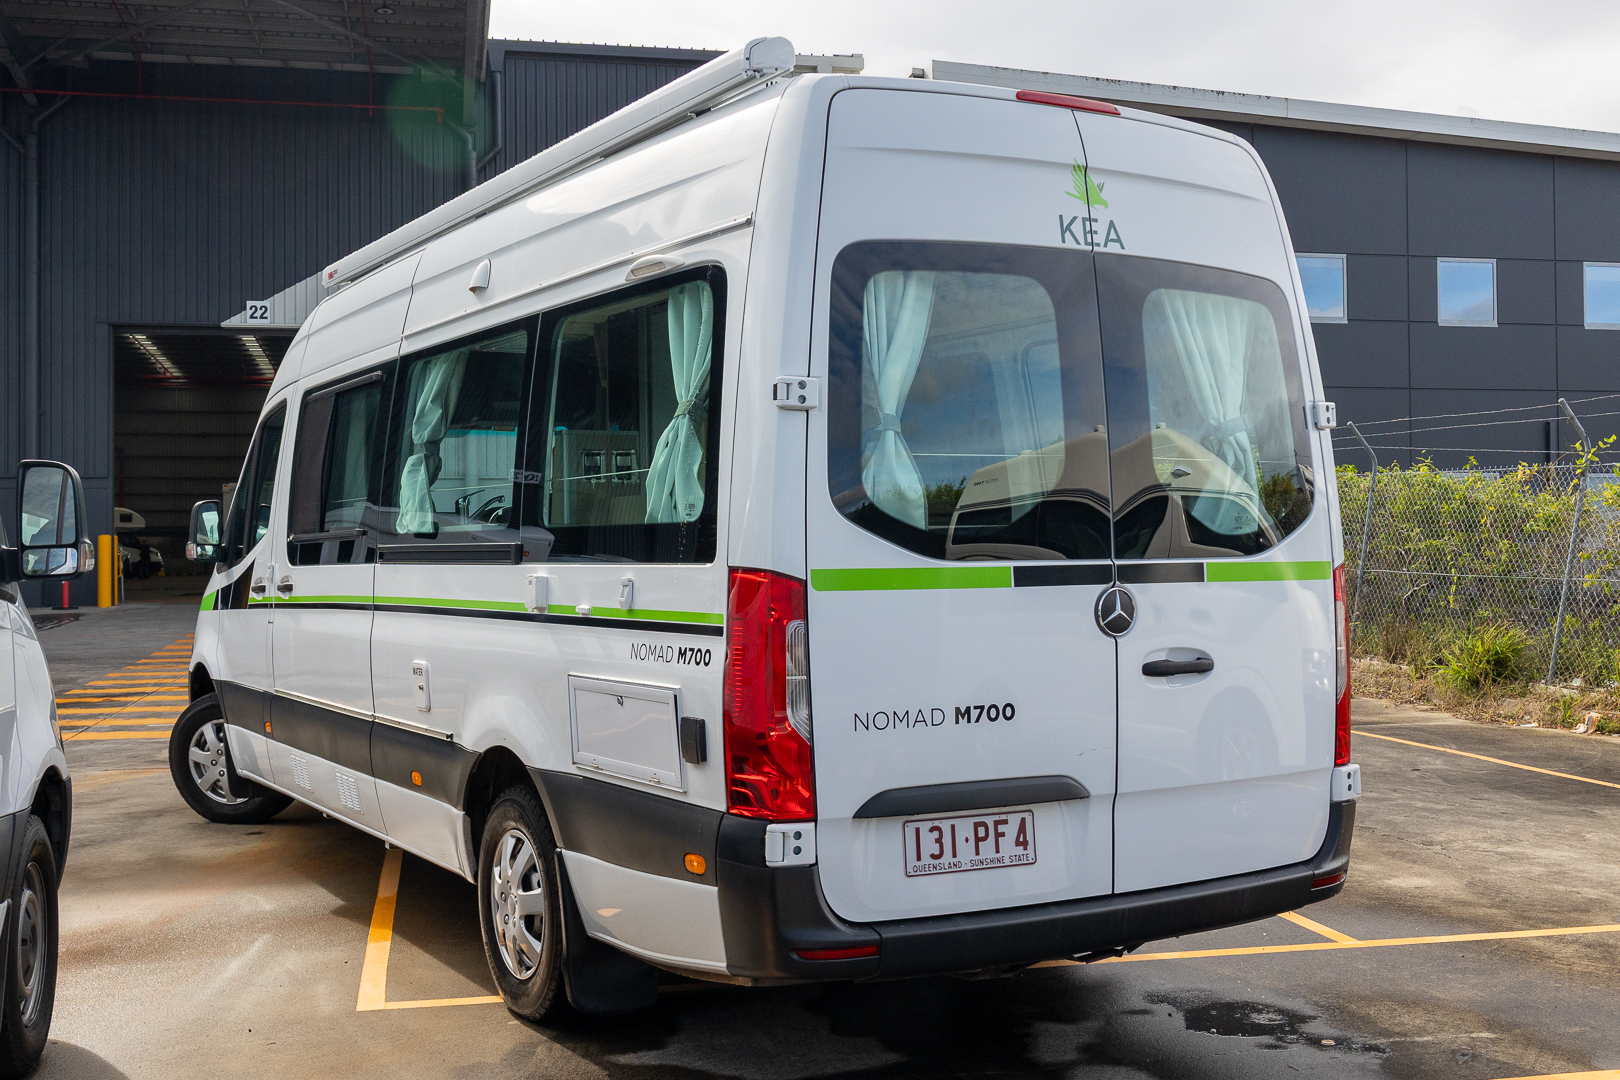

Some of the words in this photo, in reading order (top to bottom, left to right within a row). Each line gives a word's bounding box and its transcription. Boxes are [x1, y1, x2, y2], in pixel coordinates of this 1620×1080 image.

[1058, 214, 1126, 250] KEA
[249, 304, 268, 320] 22
[630, 642, 674, 663] NOMAD
[677, 646, 712, 667] M700
[854, 707, 946, 732] NOMAD
[954, 702, 1016, 725] M700
[912, 862, 963, 873] QUEENSLAND
[969, 855, 1006, 868] SUNSHINE
[1008, 853, 1030, 864] STATE
